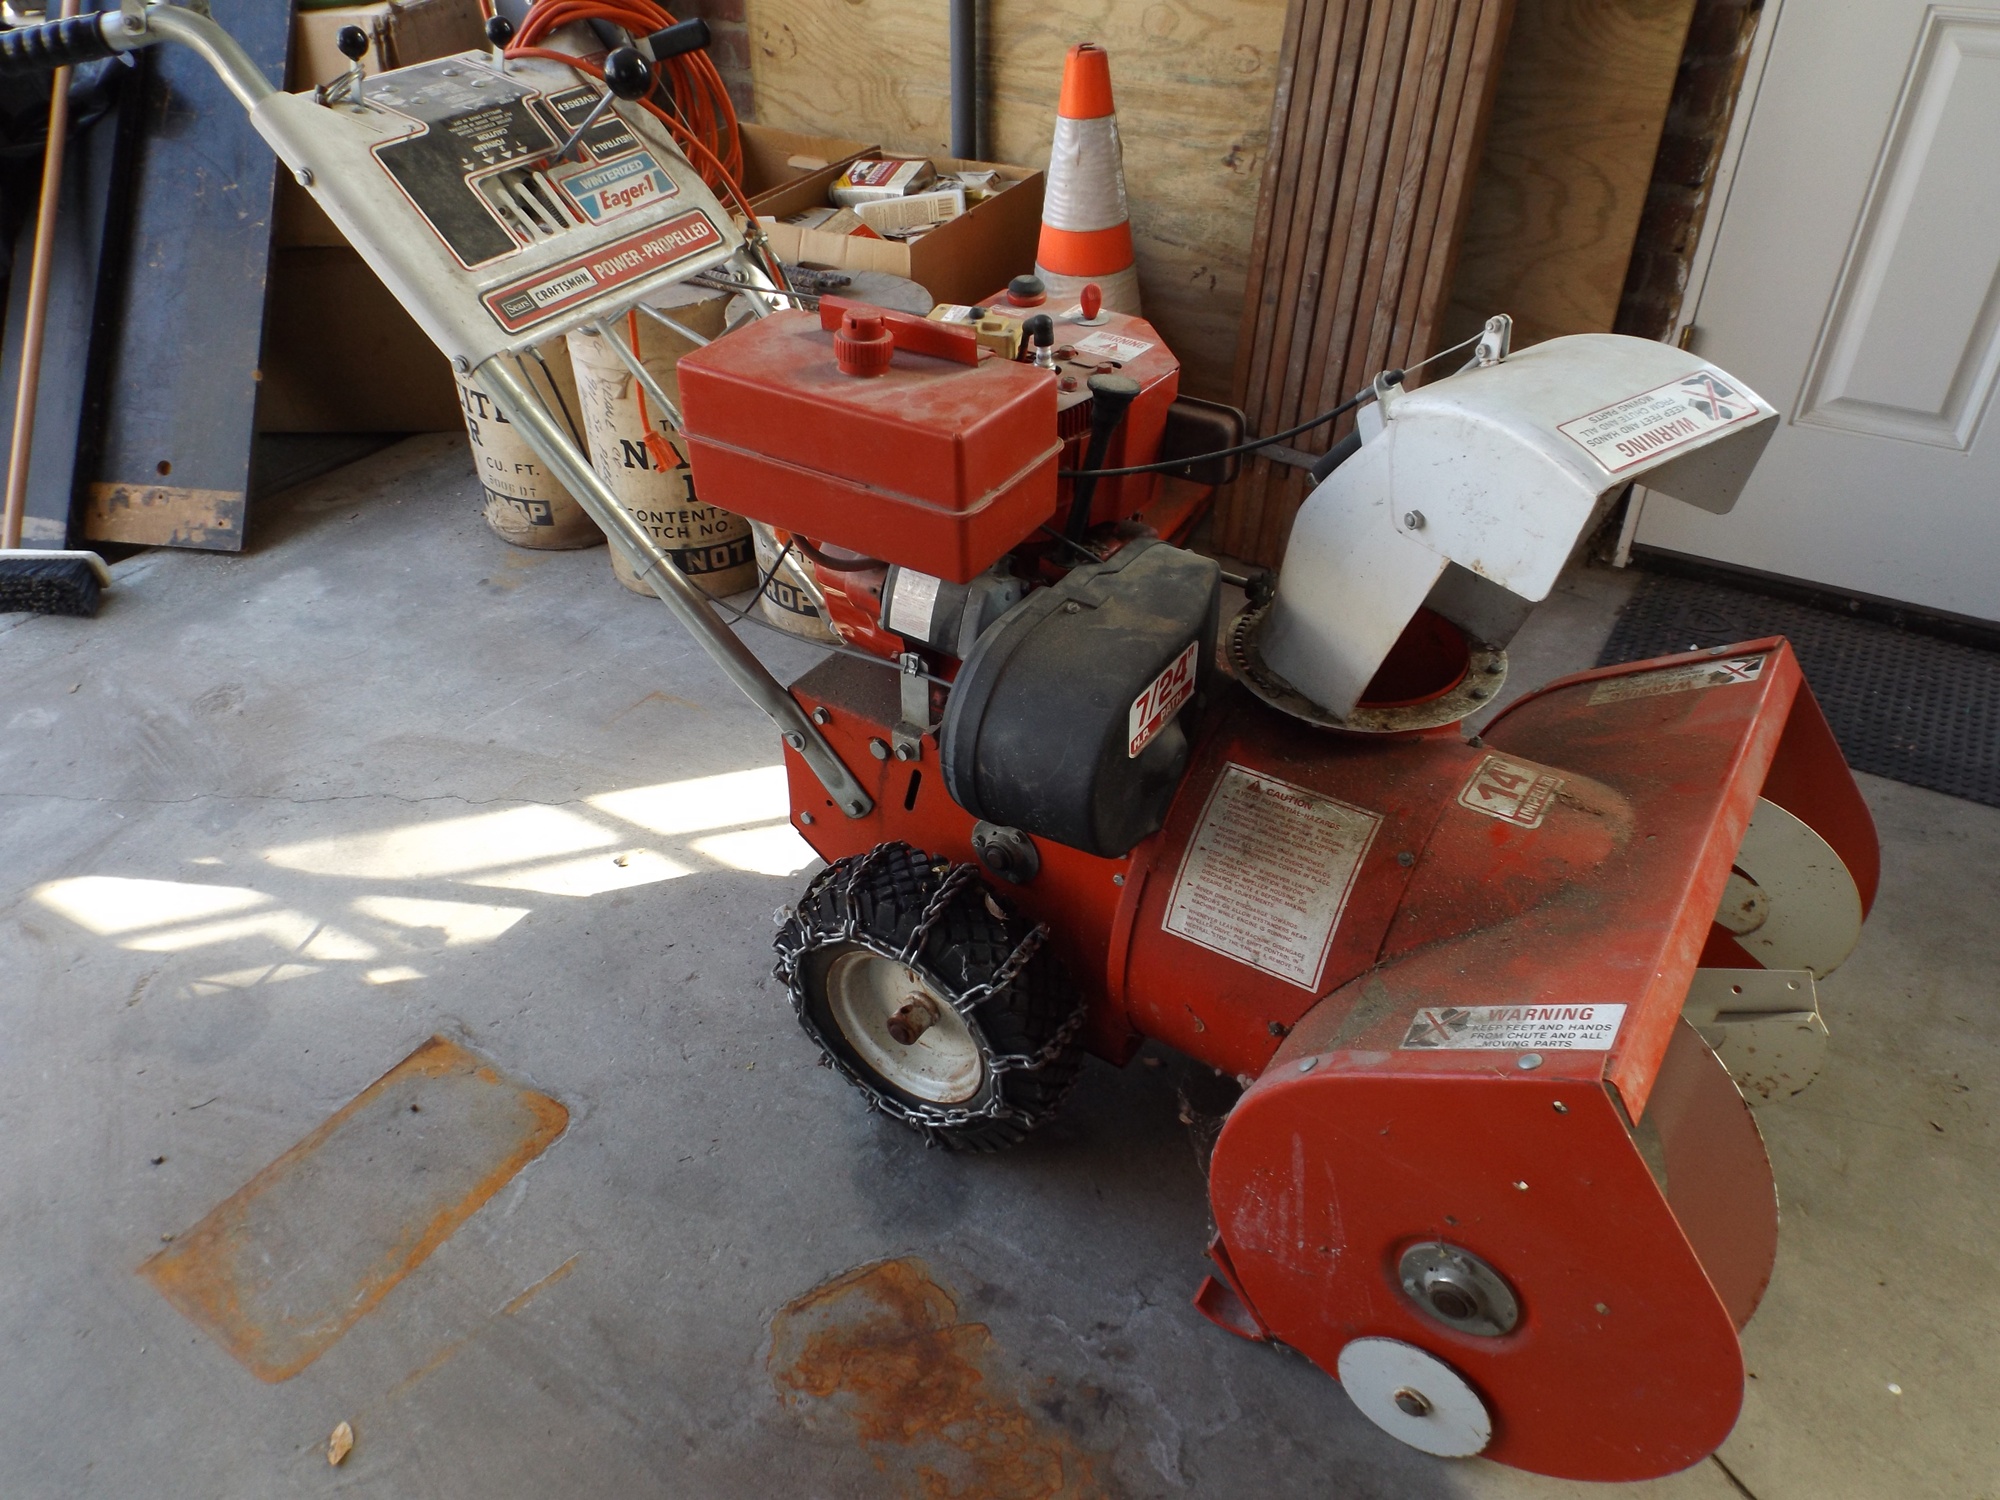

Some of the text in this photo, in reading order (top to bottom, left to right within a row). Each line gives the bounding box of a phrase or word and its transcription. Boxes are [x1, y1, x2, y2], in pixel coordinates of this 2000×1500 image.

[477, 128, 508, 142] CAUTION
[597, 133, 634, 152] NEUTRAL
[580, 160, 644, 190] WINTERIZED
[599, 174, 654, 210] Eager-1
[505, 222, 710, 314] Sears CRAFTSMAN POWER-PROPELLED
[1579, 398, 1676, 438] FROM CHUTE AND ALL
[1588, 395, 1655, 423] MOVING PARTS
[1587, 404, 1687, 447] KEEP FEET AND HANDS
[1615, 416, 1701, 457] WARNING
[486, 456, 540, 476] CU. FT.
[628, 507, 730, 524] ONTENTS
[701, 520, 733, 536] NO.
[686, 540, 746, 572] NOT
[1136, 645, 1194, 728] 7/24"
[1133, 692, 1182, 750] H.P. PATH
[1265, 787, 1313, 810] CAUTION
[1217, 825, 1237, 836] NEVER
[1198, 874, 1222, 887] REPAIRS
[1223, 883, 1232, 891] OR
[1203, 861, 1240, 879] UNCLOGGING
[1269, 887, 1296, 901] HOUSING
[1297, 898, 1307, 906] OR
[1218, 859, 1251, 876] OPERATING
[1281, 884, 1305, 897] BEFORE
[1258, 868, 1290, 884] WHENEVER
[1290, 880, 1316, 894] LEAVING
[1277, 862, 1301, 875] COVERS
[1201, 868, 1233, 884] DISCHARGE
[1233, 880, 1253, 892] CHUTE
[1260, 891, 1283, 904] BEFORE
[1283, 900, 1307, 913] MAKING
[1190, 897, 1215, 911] MACHINE
[1217, 908, 1234, 919] WHILE
[1235, 915, 1258, 928] ENGINE
[1193, 891, 1307, 941] WINDOWS OR ALLOW BYSTANDERS NEAR
[1194, 884, 1298, 929] NEVER DIRECT DISCHARGE TOWARDS
[1185, 914, 1213, 929] IMPELLER
[1263, 945, 1291, 961] CONTROL
[1187, 907, 1305, 959] WHENEVER LEAVING MACHINE DISENGAGE
[1267, 954, 1291, 968] REMOVE
[1488, 1007, 1594, 1021] WARNING
